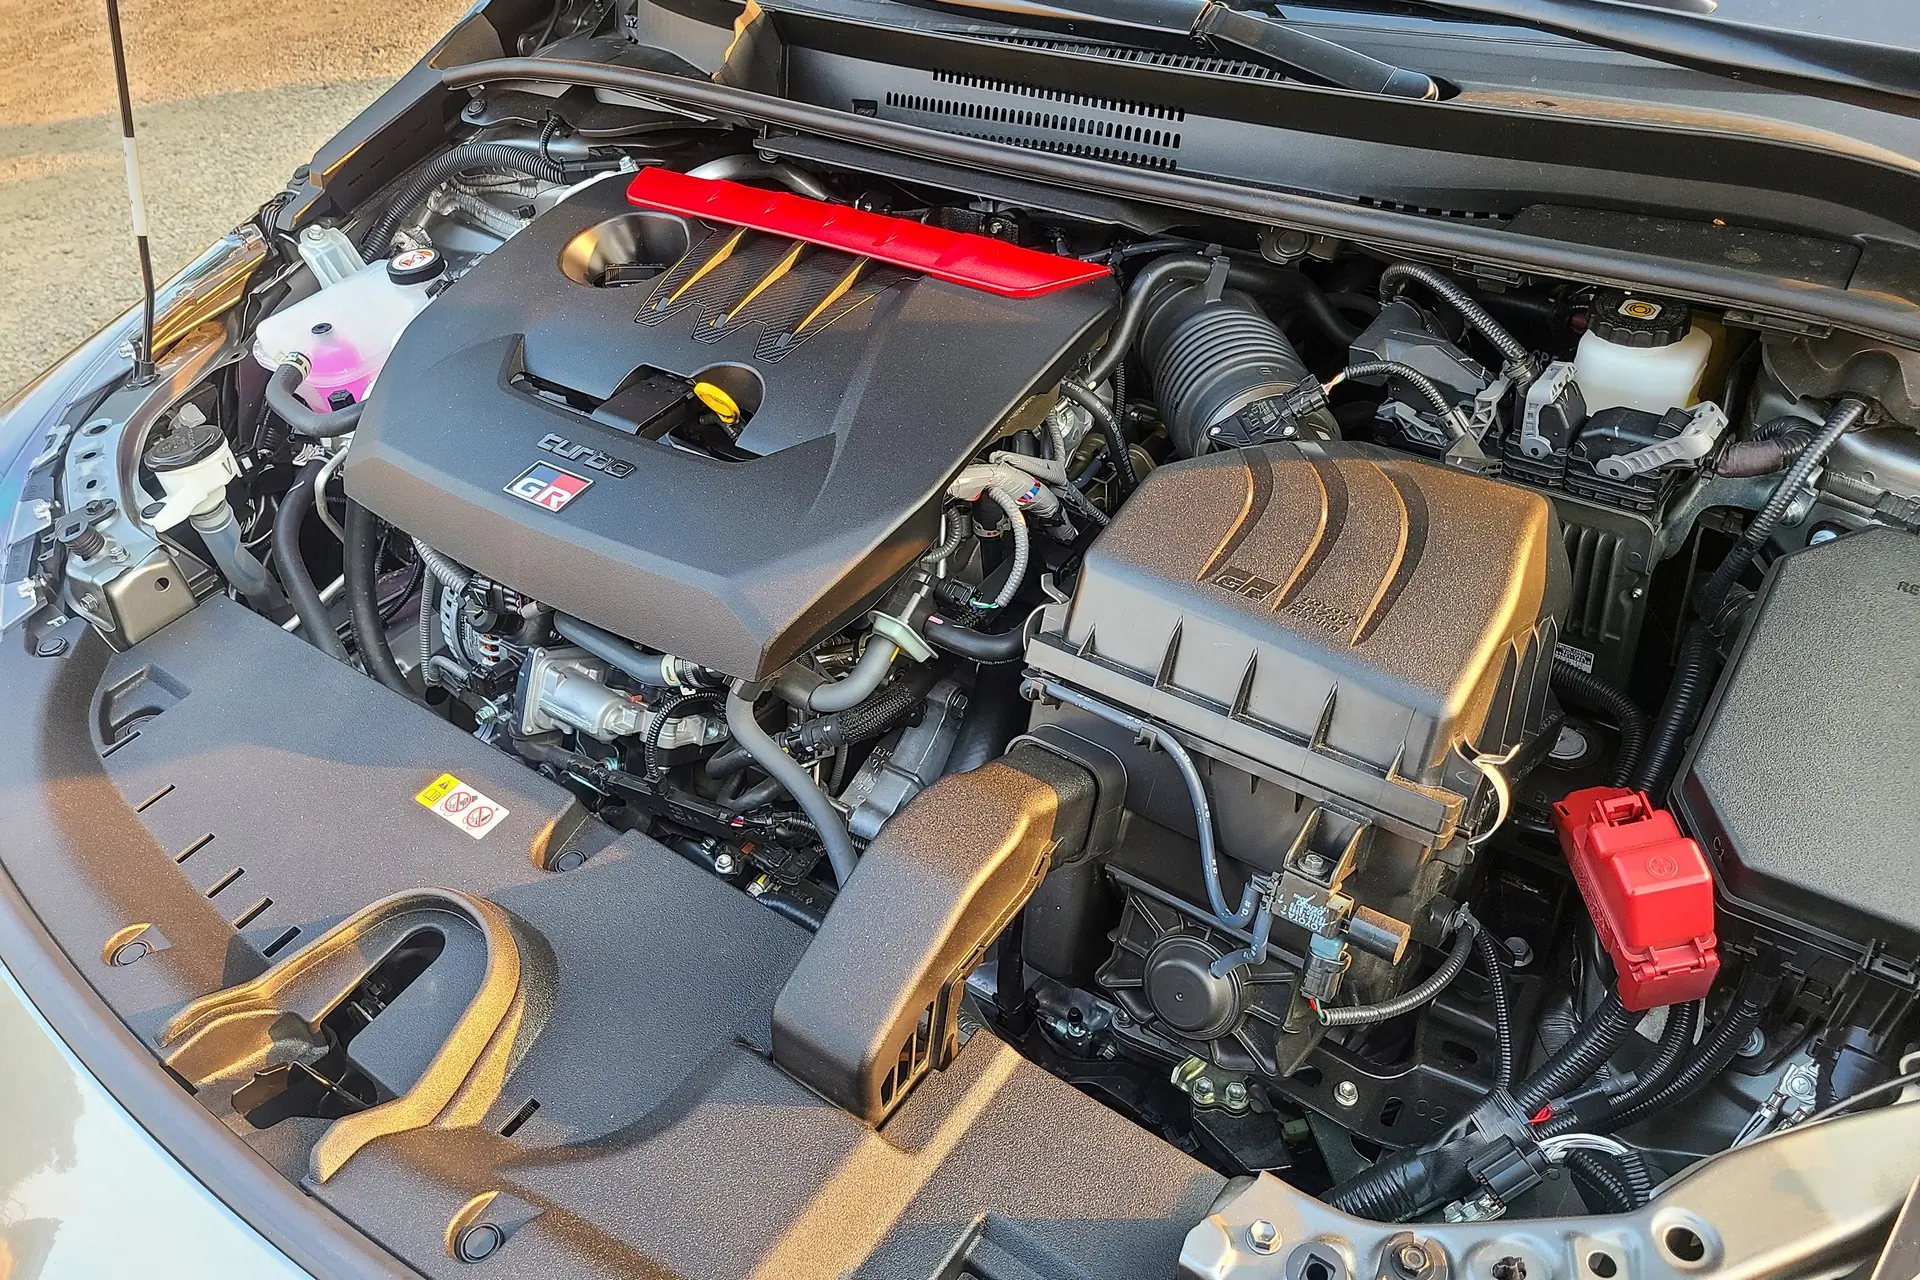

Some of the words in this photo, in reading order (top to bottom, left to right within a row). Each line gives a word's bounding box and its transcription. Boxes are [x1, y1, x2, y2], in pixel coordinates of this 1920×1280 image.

[537, 432, 637, 478] turbo
[512, 477, 572, 509] GR
[1215, 574, 1269, 602] GR
[1288, 911, 1322, 934] TOYOTA
